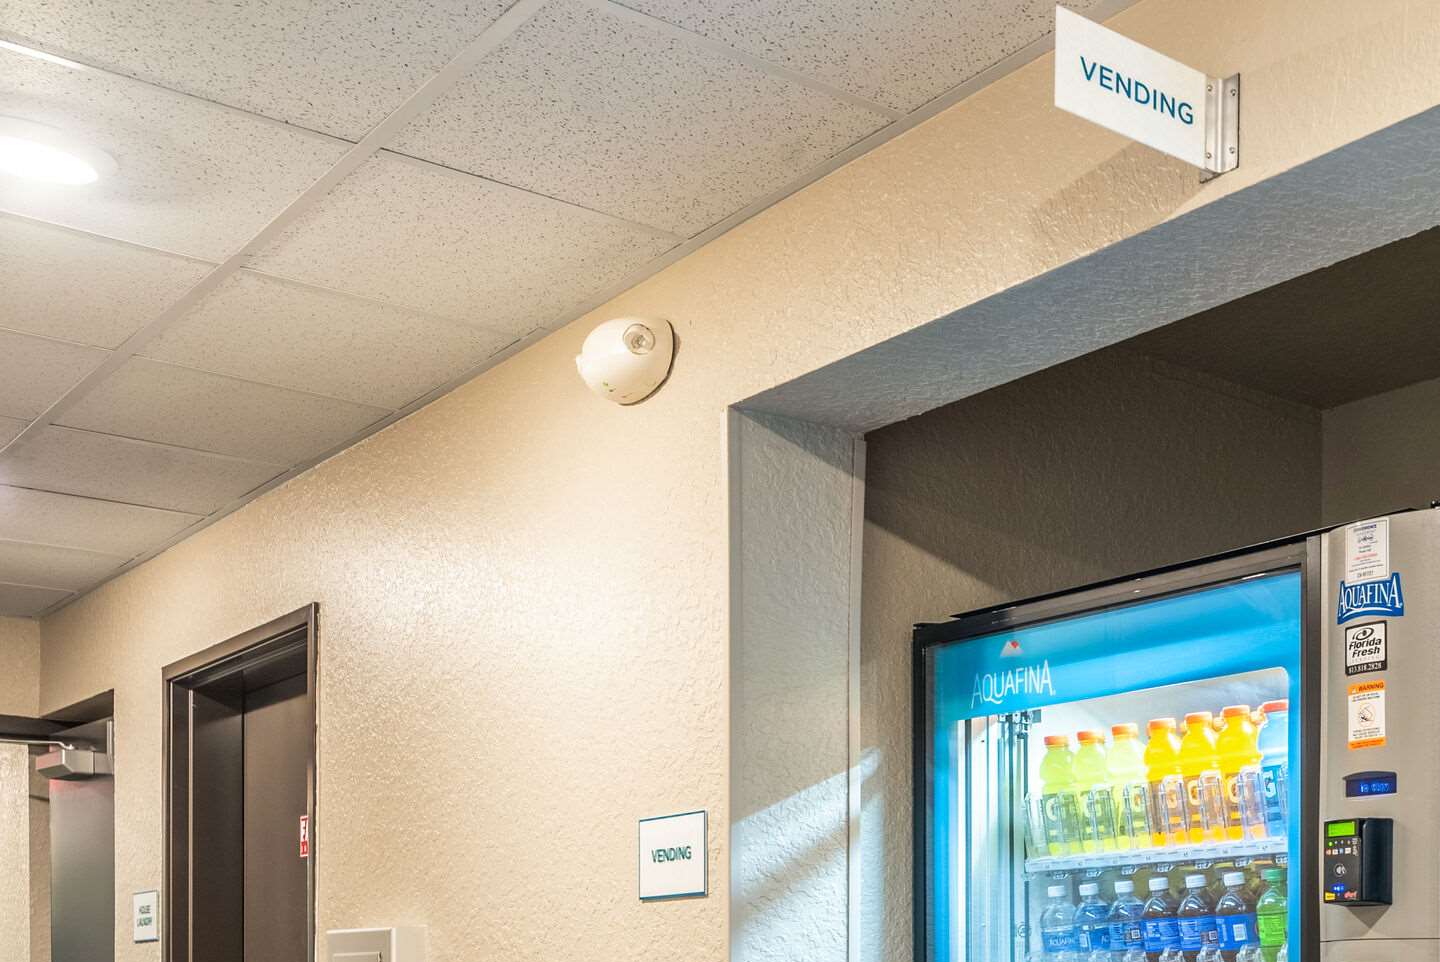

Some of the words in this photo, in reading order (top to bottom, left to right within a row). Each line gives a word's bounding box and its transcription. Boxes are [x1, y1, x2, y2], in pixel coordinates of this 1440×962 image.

[1080, 55, 1194, 125] VENDING
[1339, 576, 1402, 617] AQUAFINA
[1349, 638, 1382, 651] Florida
[1352, 646, 1380, 658] Fresh
[971, 660, 1053, 709] AQUAFINA
[651, 846, 692, 863] VENDING
